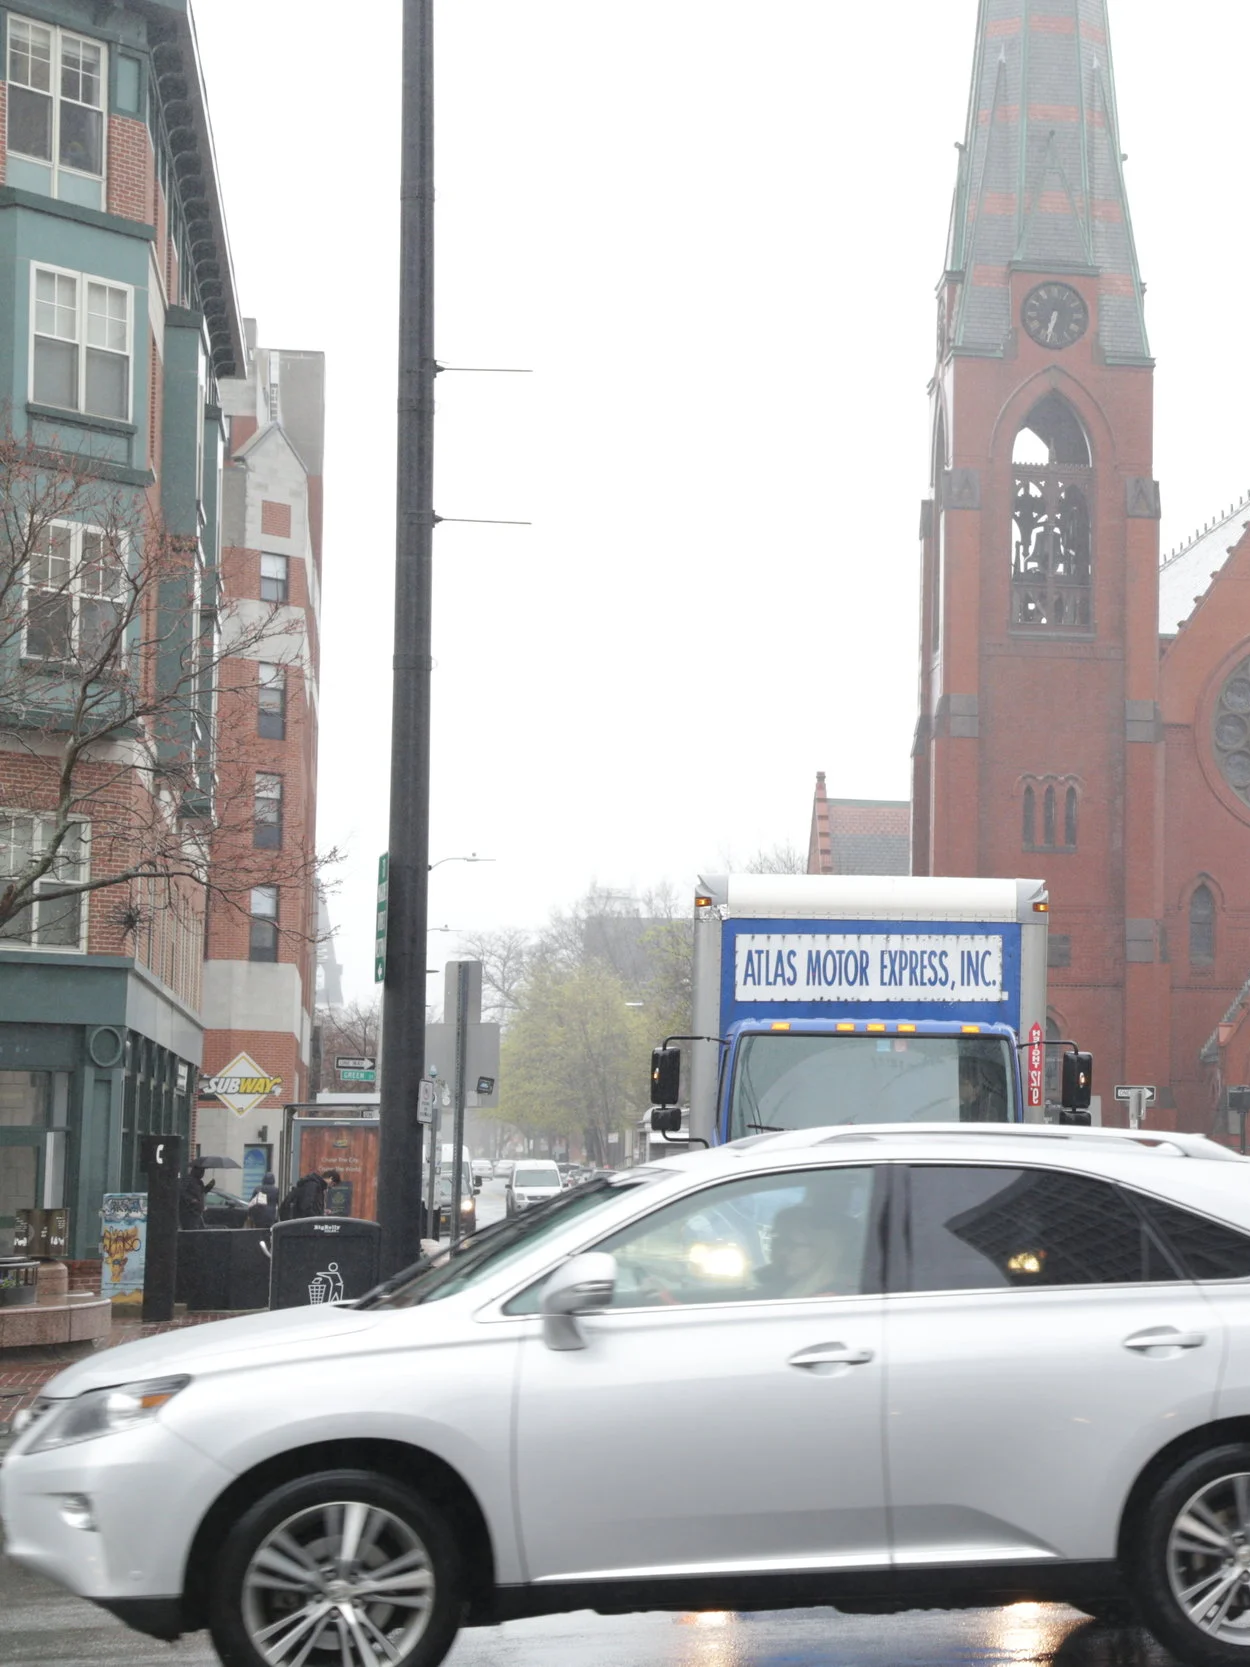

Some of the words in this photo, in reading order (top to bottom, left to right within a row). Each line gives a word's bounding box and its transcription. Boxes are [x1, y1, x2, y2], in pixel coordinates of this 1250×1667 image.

[742, 949, 797, 987] ATLAS
[805, 949, 869, 987] MOTOR
[879, 950, 956, 991] EXPRESS,
[960, 950, 997, 987] INC.
[343, 1071, 365, 1080] GREEN
[203, 1077, 282, 1095] SUBWAY
